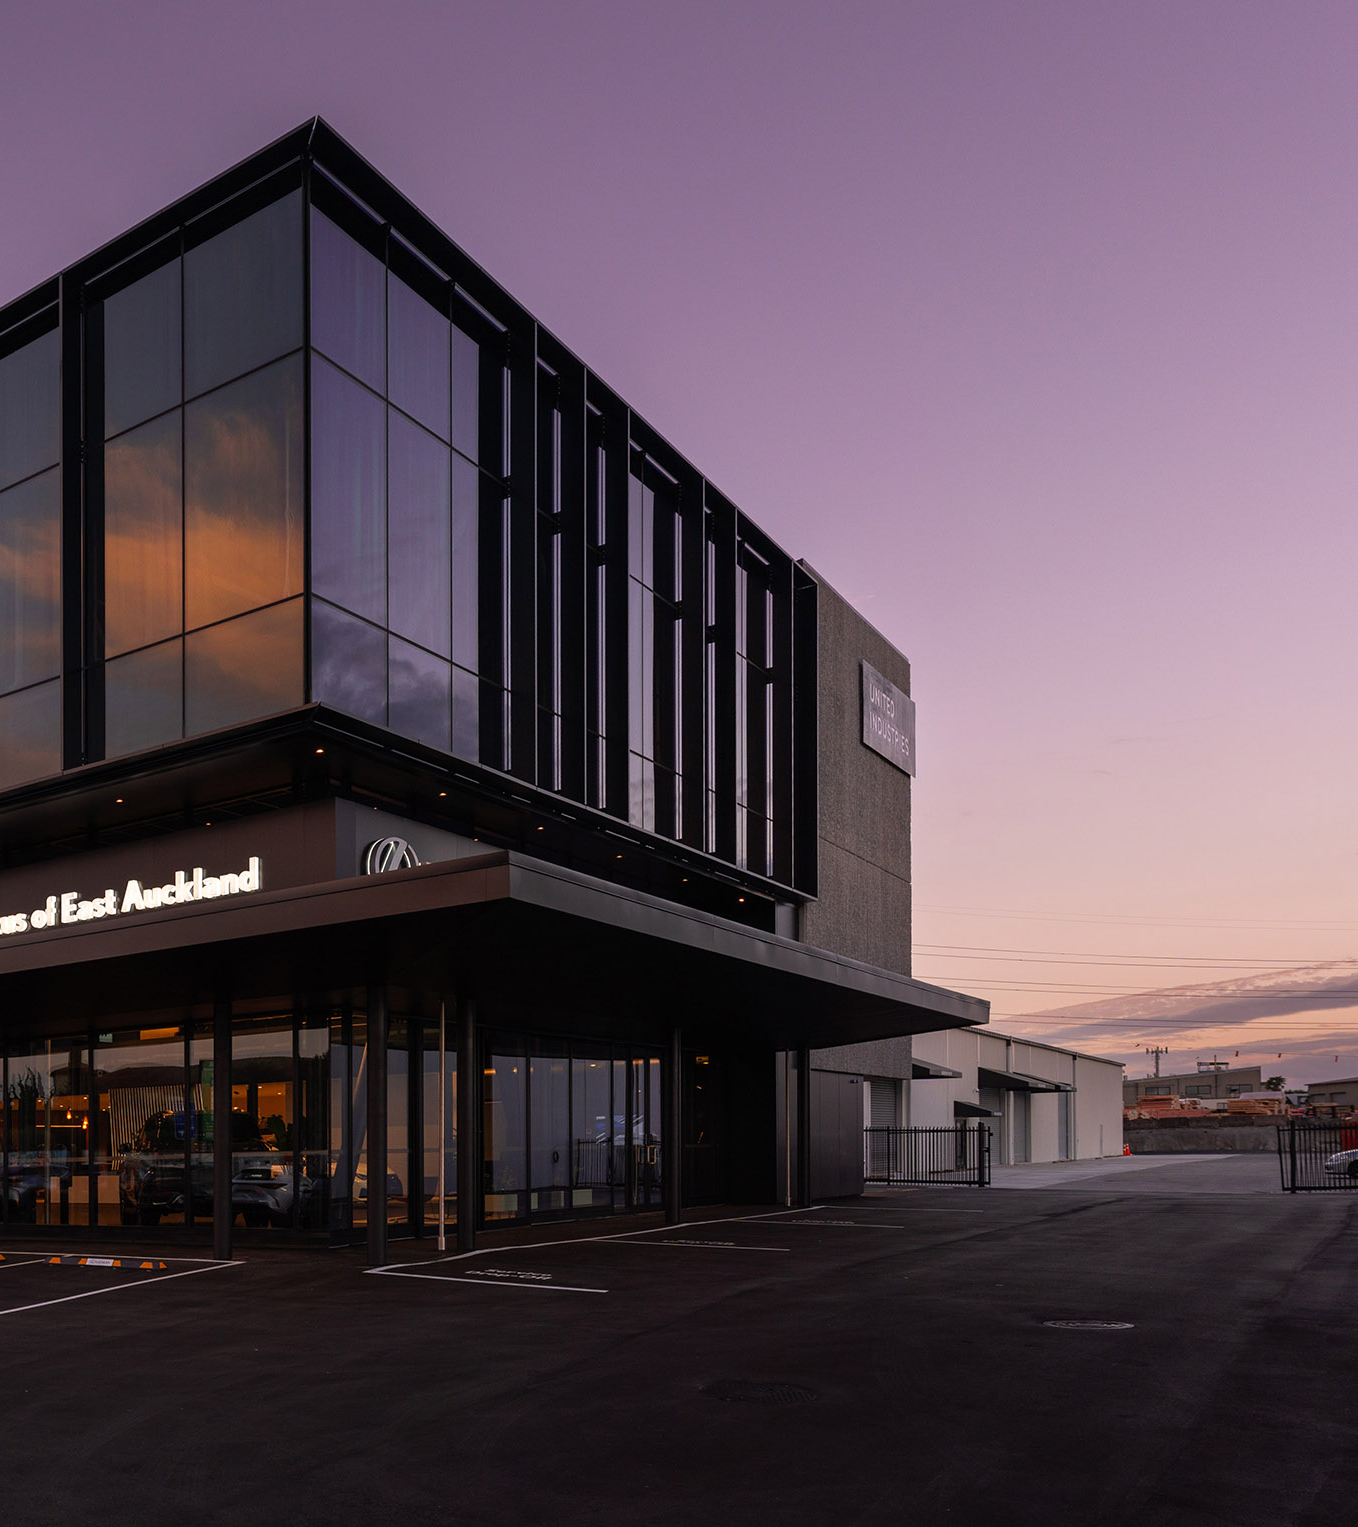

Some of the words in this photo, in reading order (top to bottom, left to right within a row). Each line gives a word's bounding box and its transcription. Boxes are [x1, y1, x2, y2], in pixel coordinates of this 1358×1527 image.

[869, 683, 895, 718] UNITED
[869, 711, 910, 756] INDUSTRES
[30, 896, 57, 928] of
[61, 891, 117, 923] East
[121, 856, 260, 912] Auckland
